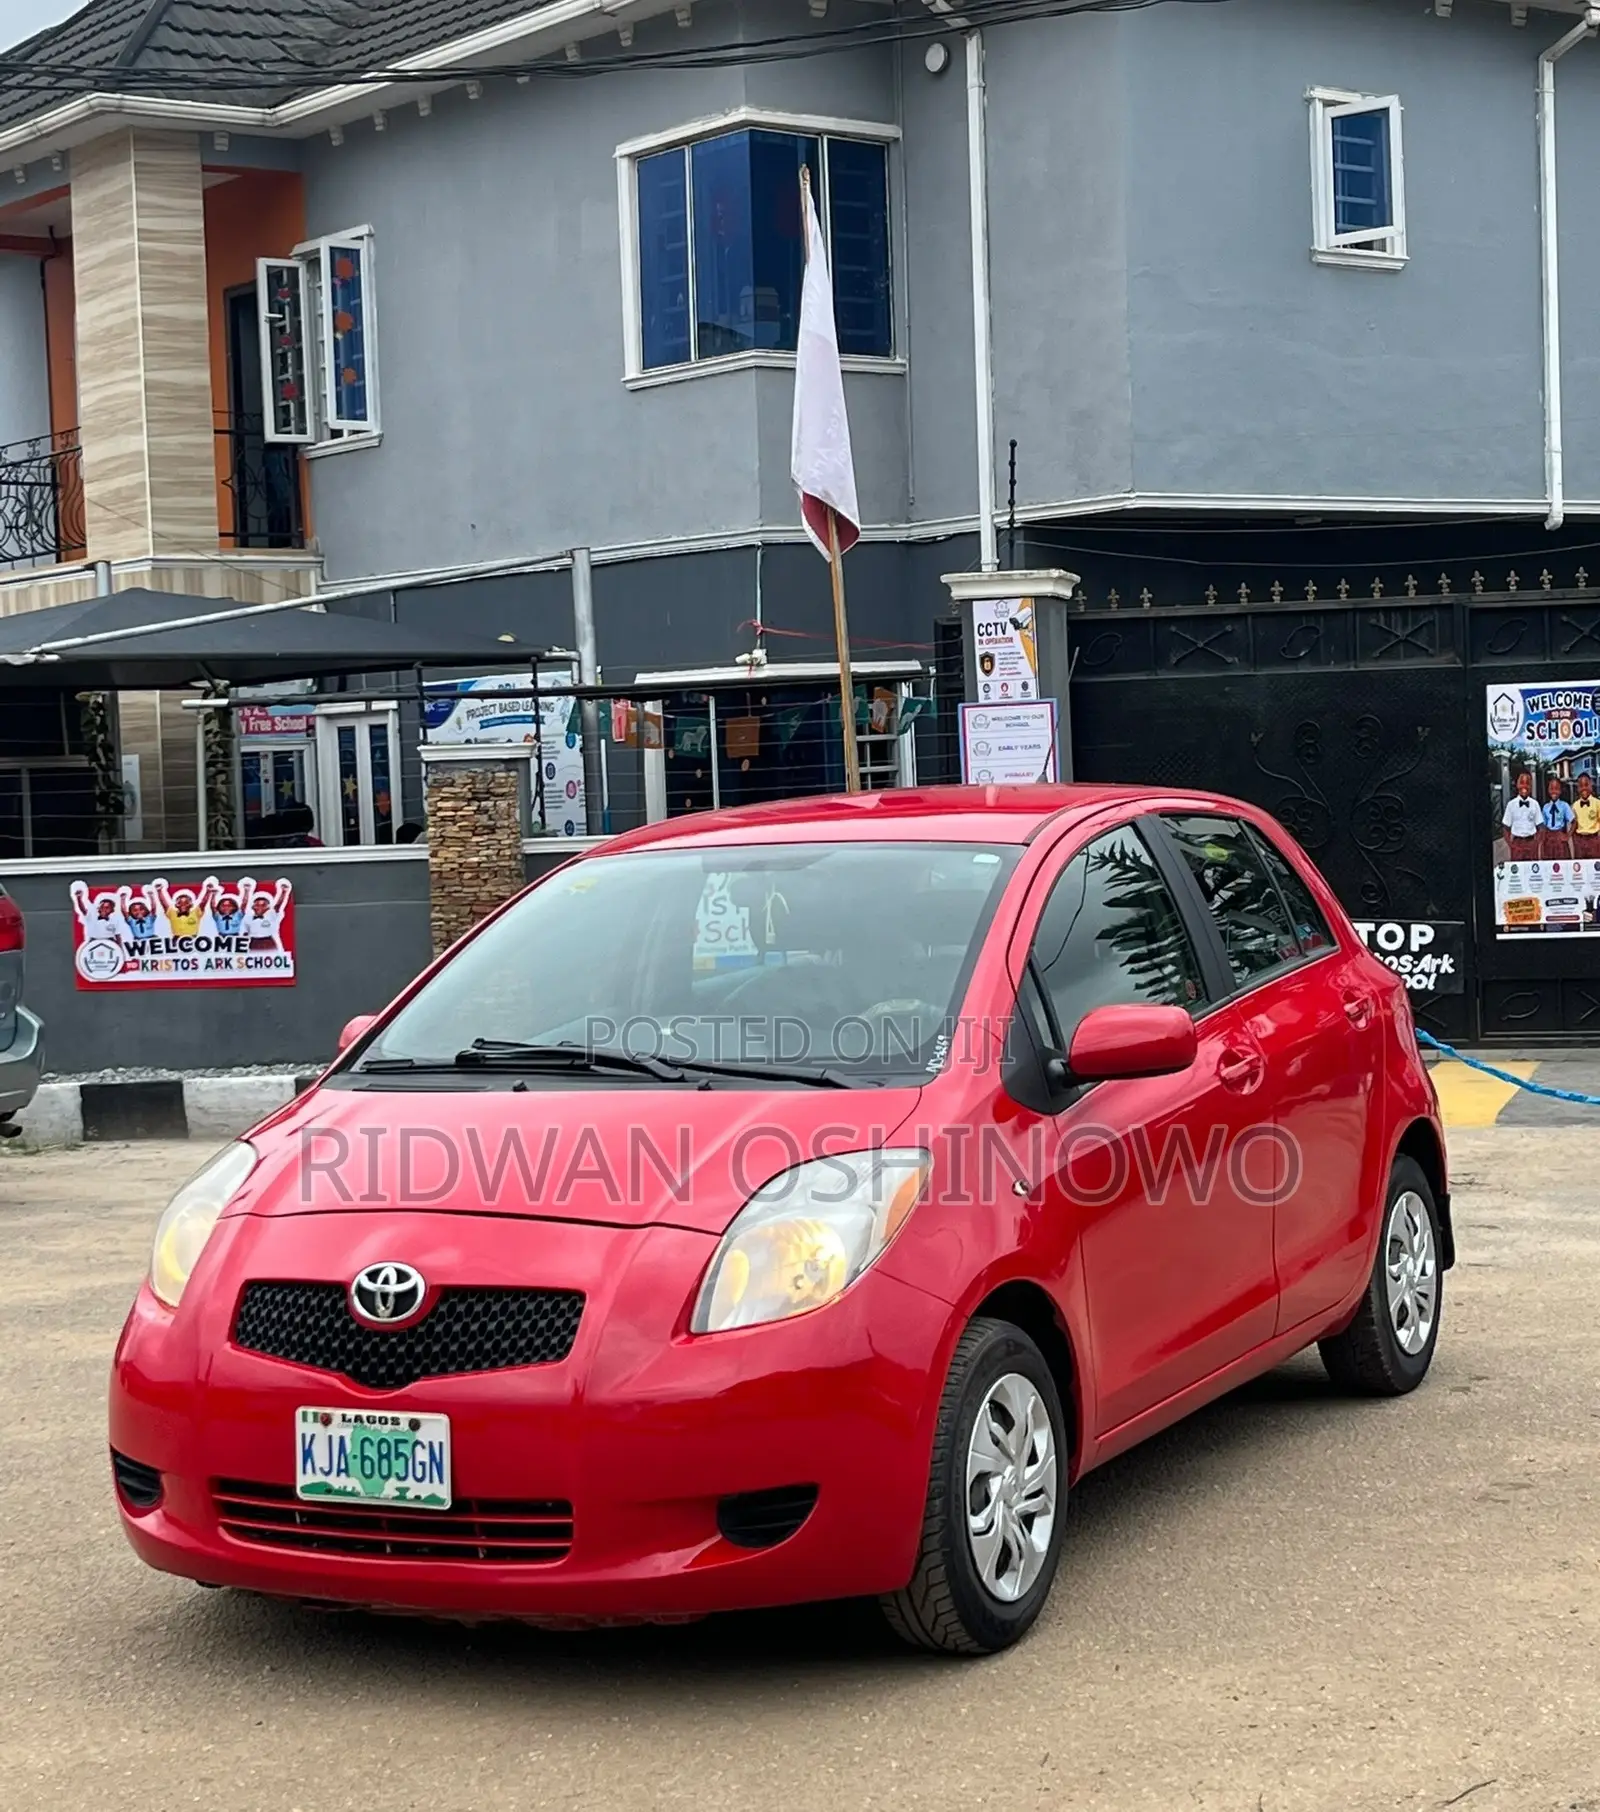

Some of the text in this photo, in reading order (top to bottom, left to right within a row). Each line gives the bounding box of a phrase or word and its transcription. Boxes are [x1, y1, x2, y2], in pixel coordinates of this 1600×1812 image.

[977, 621, 1008, 637] CCTV
[466, 703, 497, 720] PROJECT
[498, 701, 521, 713] BASED
[1527, 692, 1591, 713] WELCOME
[249, 716, 272, 732] Free
[274, 715, 307, 731] School
[1526, 718, 1599, 740] SCHOOL!
[123, 936, 250, 957] WELCOME
[141, 959, 199, 973] KRISTOS
[205, 957, 233, 971] ARK
[237, 955, 290, 970] SCHOOL
[340, 1413, 401, 1426] LAGOS
